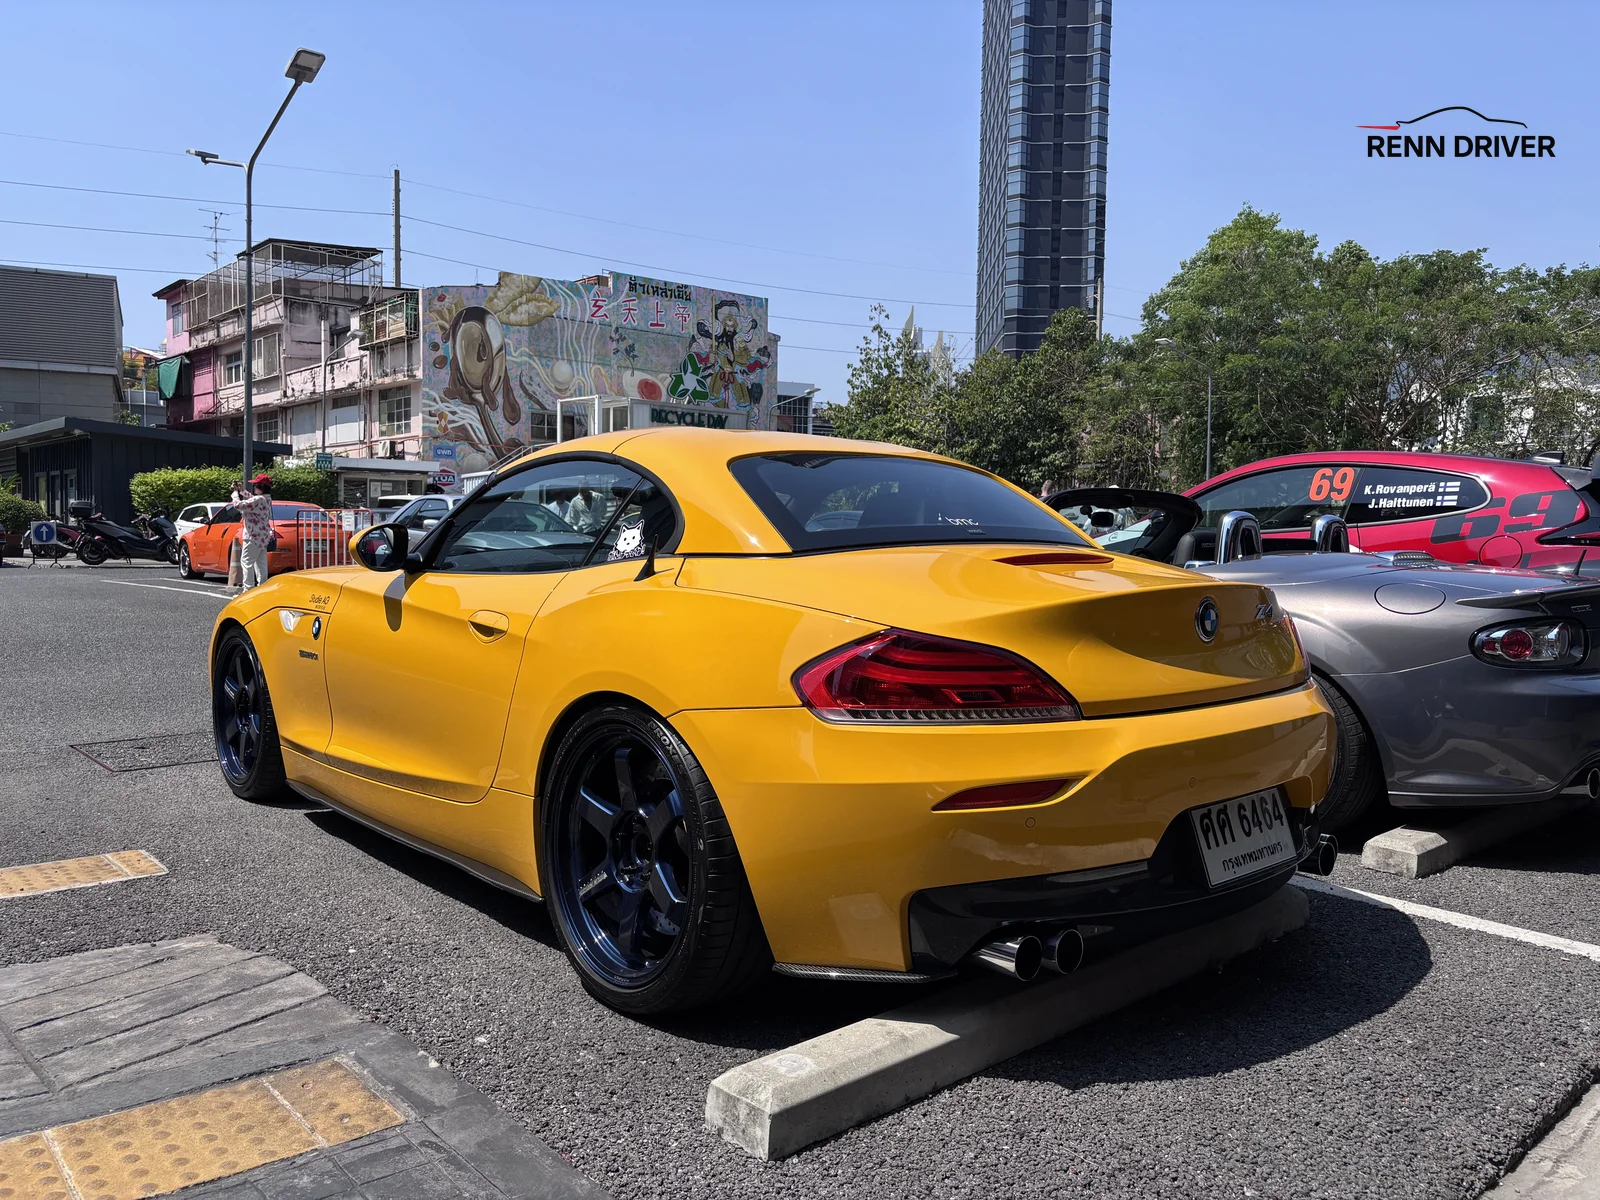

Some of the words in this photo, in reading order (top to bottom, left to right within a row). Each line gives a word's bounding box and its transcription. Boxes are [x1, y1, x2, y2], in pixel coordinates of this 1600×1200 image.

[650, 408, 706, 428] RECYCLE
[707, 413, 729, 430] DAY
[1309, 467, 1355, 502] 69
[1430, 489, 1581, 544] 69
[1254, 603, 1274, 620] Z4
[1237, 793, 1285, 838] 6464
[1222, 841, 1283, 874] กรุงเทพมหานคร
